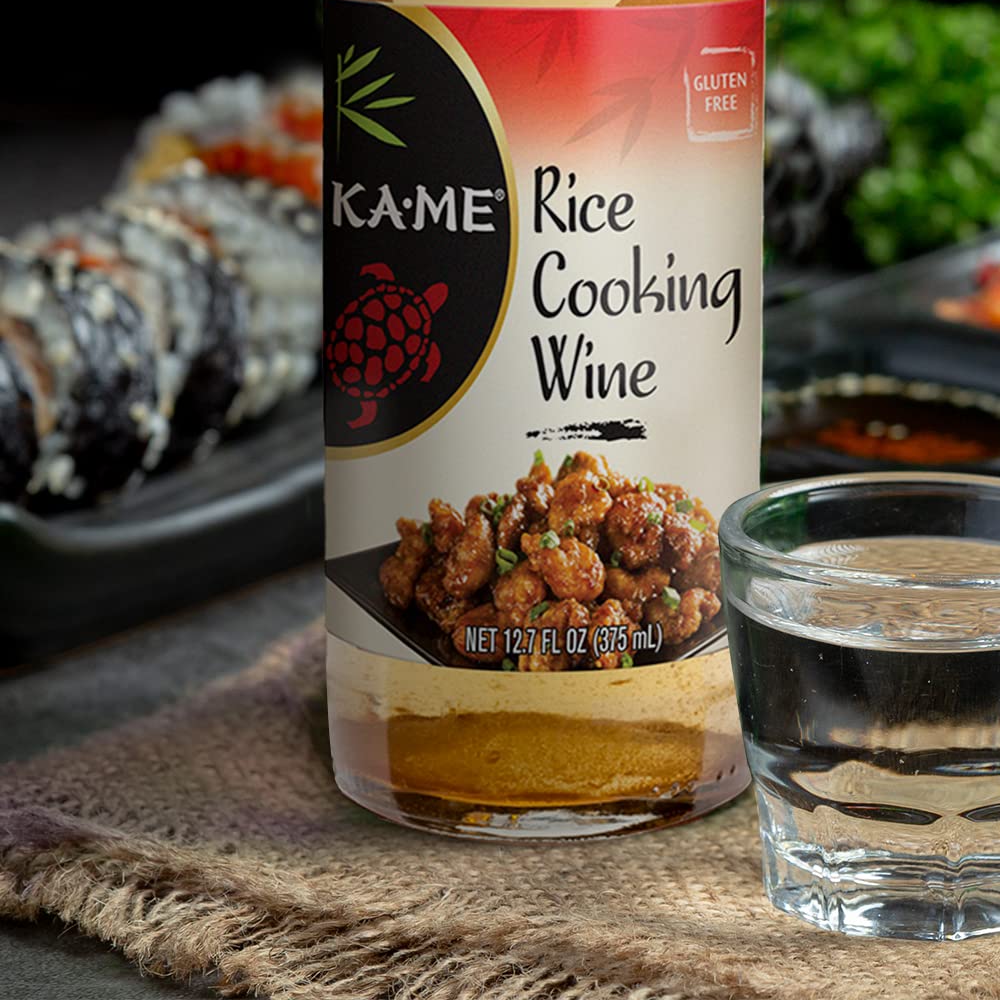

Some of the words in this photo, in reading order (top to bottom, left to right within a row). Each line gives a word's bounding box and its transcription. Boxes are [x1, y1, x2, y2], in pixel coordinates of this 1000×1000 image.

[693, 71, 748, 92] GLUTEN
[705, 94, 738, 113] FREE
[533, 164, 636, 234] Rice
[531, 244, 743, 346] Cooking
[530, 333, 658, 403] Wine
[465, 627, 498, 653] NET
[503, 628, 537, 655] 12.7
[541, 629, 561, 655] FL
[566, 628, 588, 655] OZ
[592, 625, 628, 658] (375
[632, 623, 664, 653] mL)
